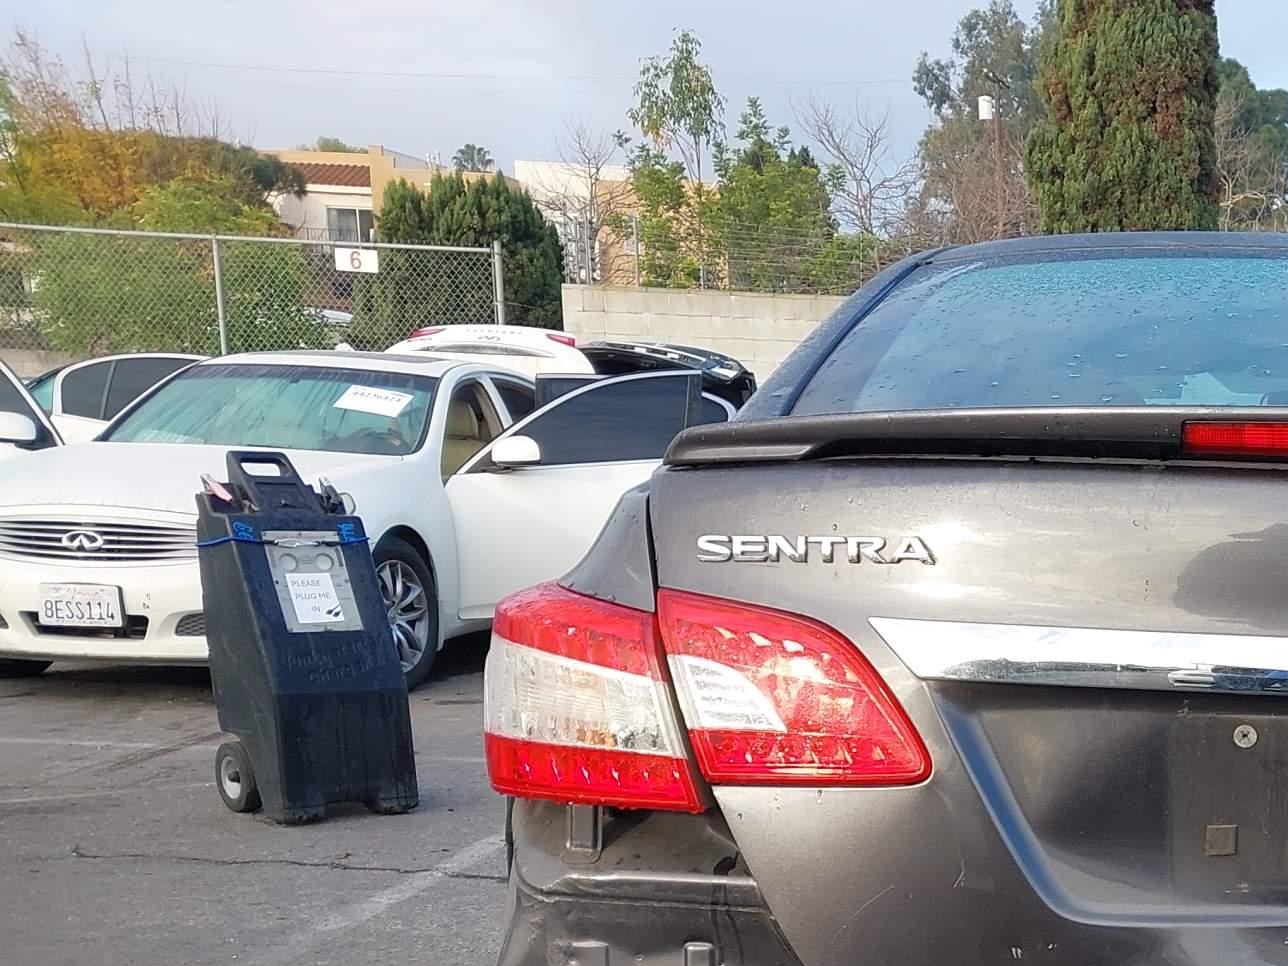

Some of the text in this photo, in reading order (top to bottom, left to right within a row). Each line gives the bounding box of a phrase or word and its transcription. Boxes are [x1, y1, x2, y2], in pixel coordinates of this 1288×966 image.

[351, 251, 362, 269] 6
[696, 535, 936, 565] SENTRA
[291, 579, 321, 588] PLEASE
[295, 591, 332, 601] PLUG ME
[44, 599, 115, 621] 8ESS114
[311, 605, 321, 613] IN
